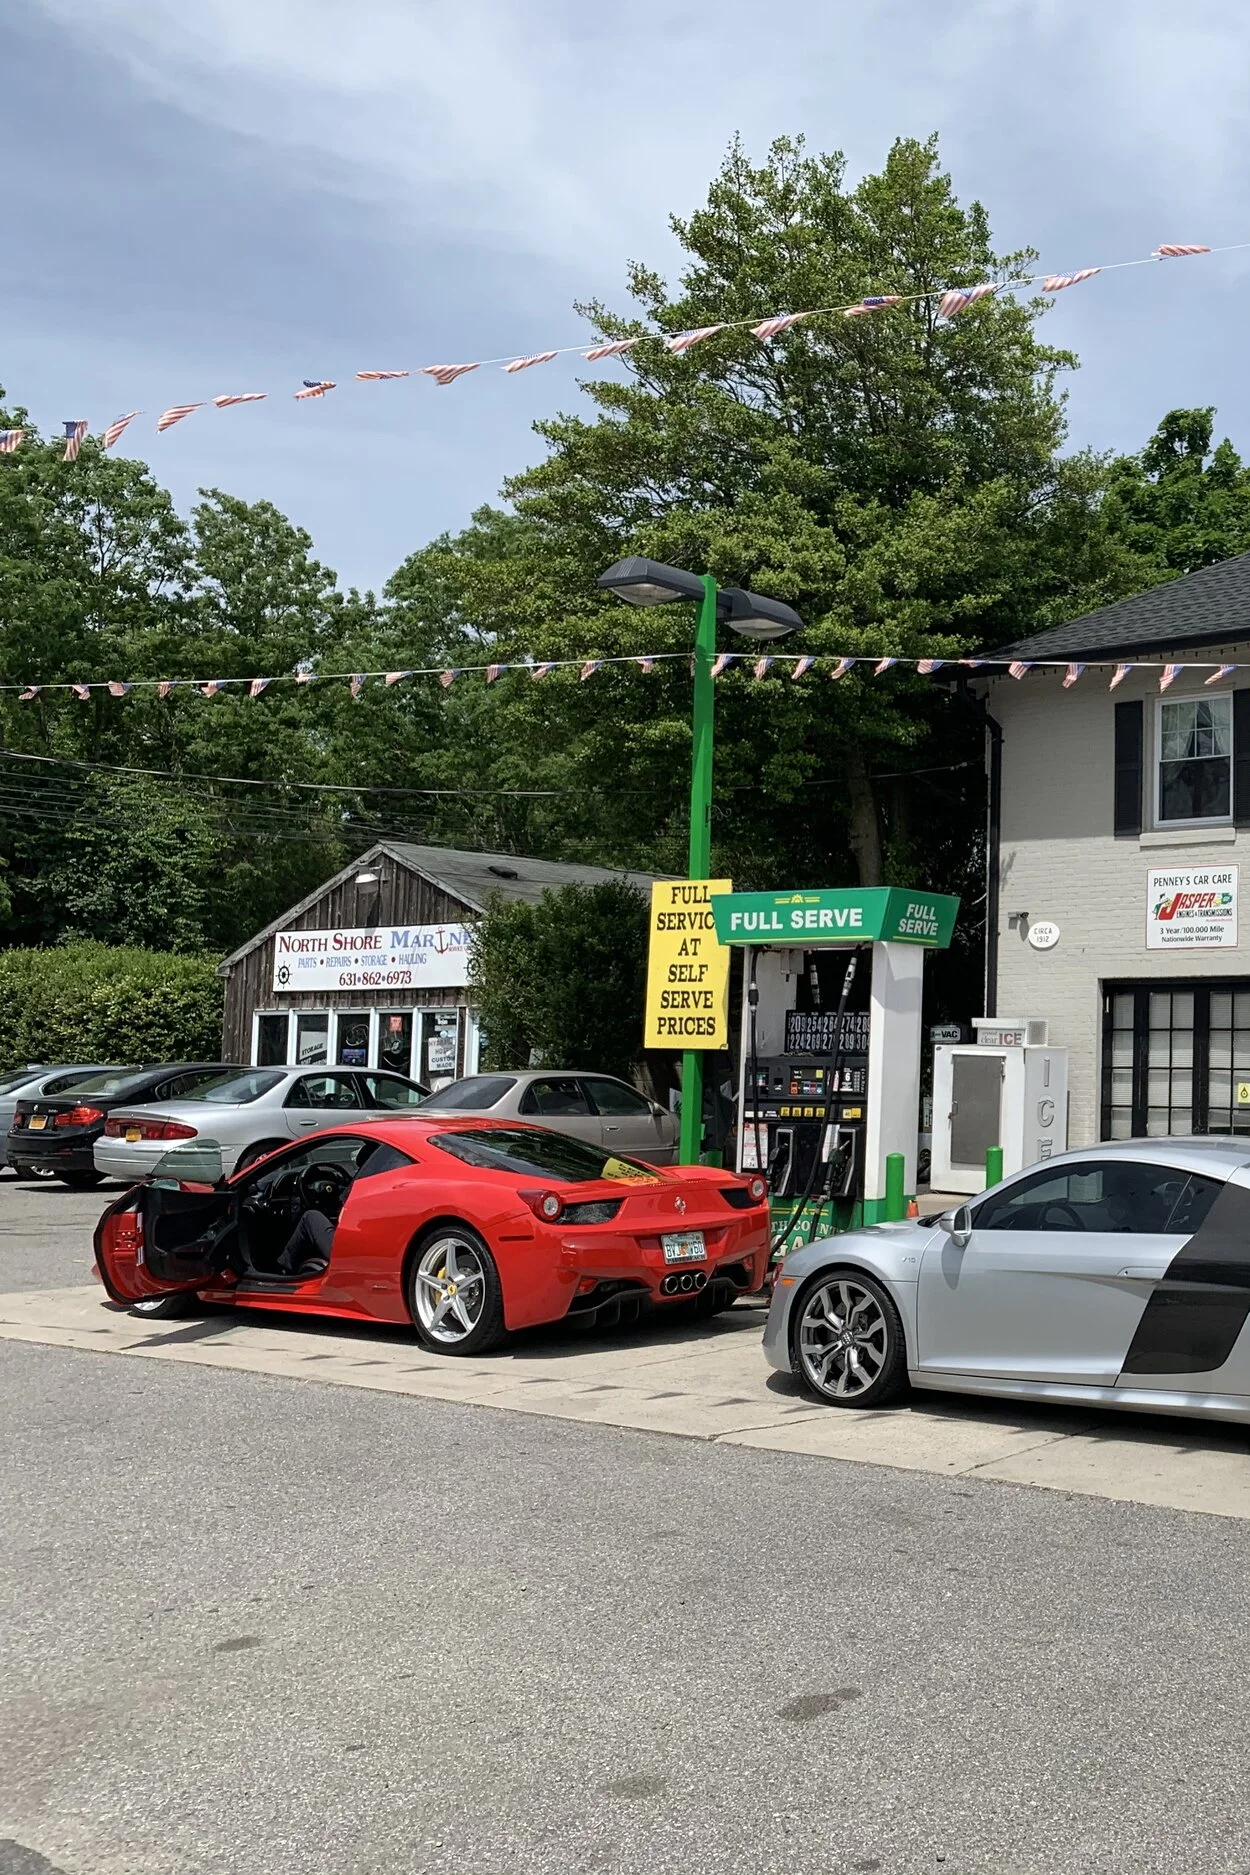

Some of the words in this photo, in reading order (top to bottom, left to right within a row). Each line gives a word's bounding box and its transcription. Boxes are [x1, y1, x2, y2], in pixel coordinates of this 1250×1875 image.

[1153, 876, 1191, 887] PENNEY'S
[1193, 875, 1209, 885] CAR
[1212, 873, 1233, 885] CARE
[671, 885, 712, 905] FULL
[906, 903, 937, 921] FULL
[1158, 892, 1217, 921] JASPER
[1176, 909, 1195, 919] ENGINES
[1197, 908, 1233, 918] TRANSMISSIONS
[656, 911, 715, 931] SERVIC
[730, 911, 784, 931] FULL
[790, 908, 863, 930] SERVE
[898, 918, 940, 937] SERVE
[1033, 927, 1053, 935] CIRCA
[1036, 935, 1050, 943] 1912
[1159, 927, 1164, 935] 3
[1209, 925, 1225, 933] Mile
[1195, 935, 1223, 943] Warranty
[278, 935, 328, 953] NORTH
[331, 932, 383, 951] SHORE
[677, 938, 702, 956] AT
[297, 957, 317, 969] PARTS
[325, 956, 352, 968] REPAIRS
[360, 955, 388, 967] STORAGE
[398, 953, 427, 965] HAULING
[667, 964, 709, 983] SELF
[660, 990, 714, 1009] SERVE
[656, 1016, 716, 1036] PRICES
[998, 1032, 1023, 1045] ICE
